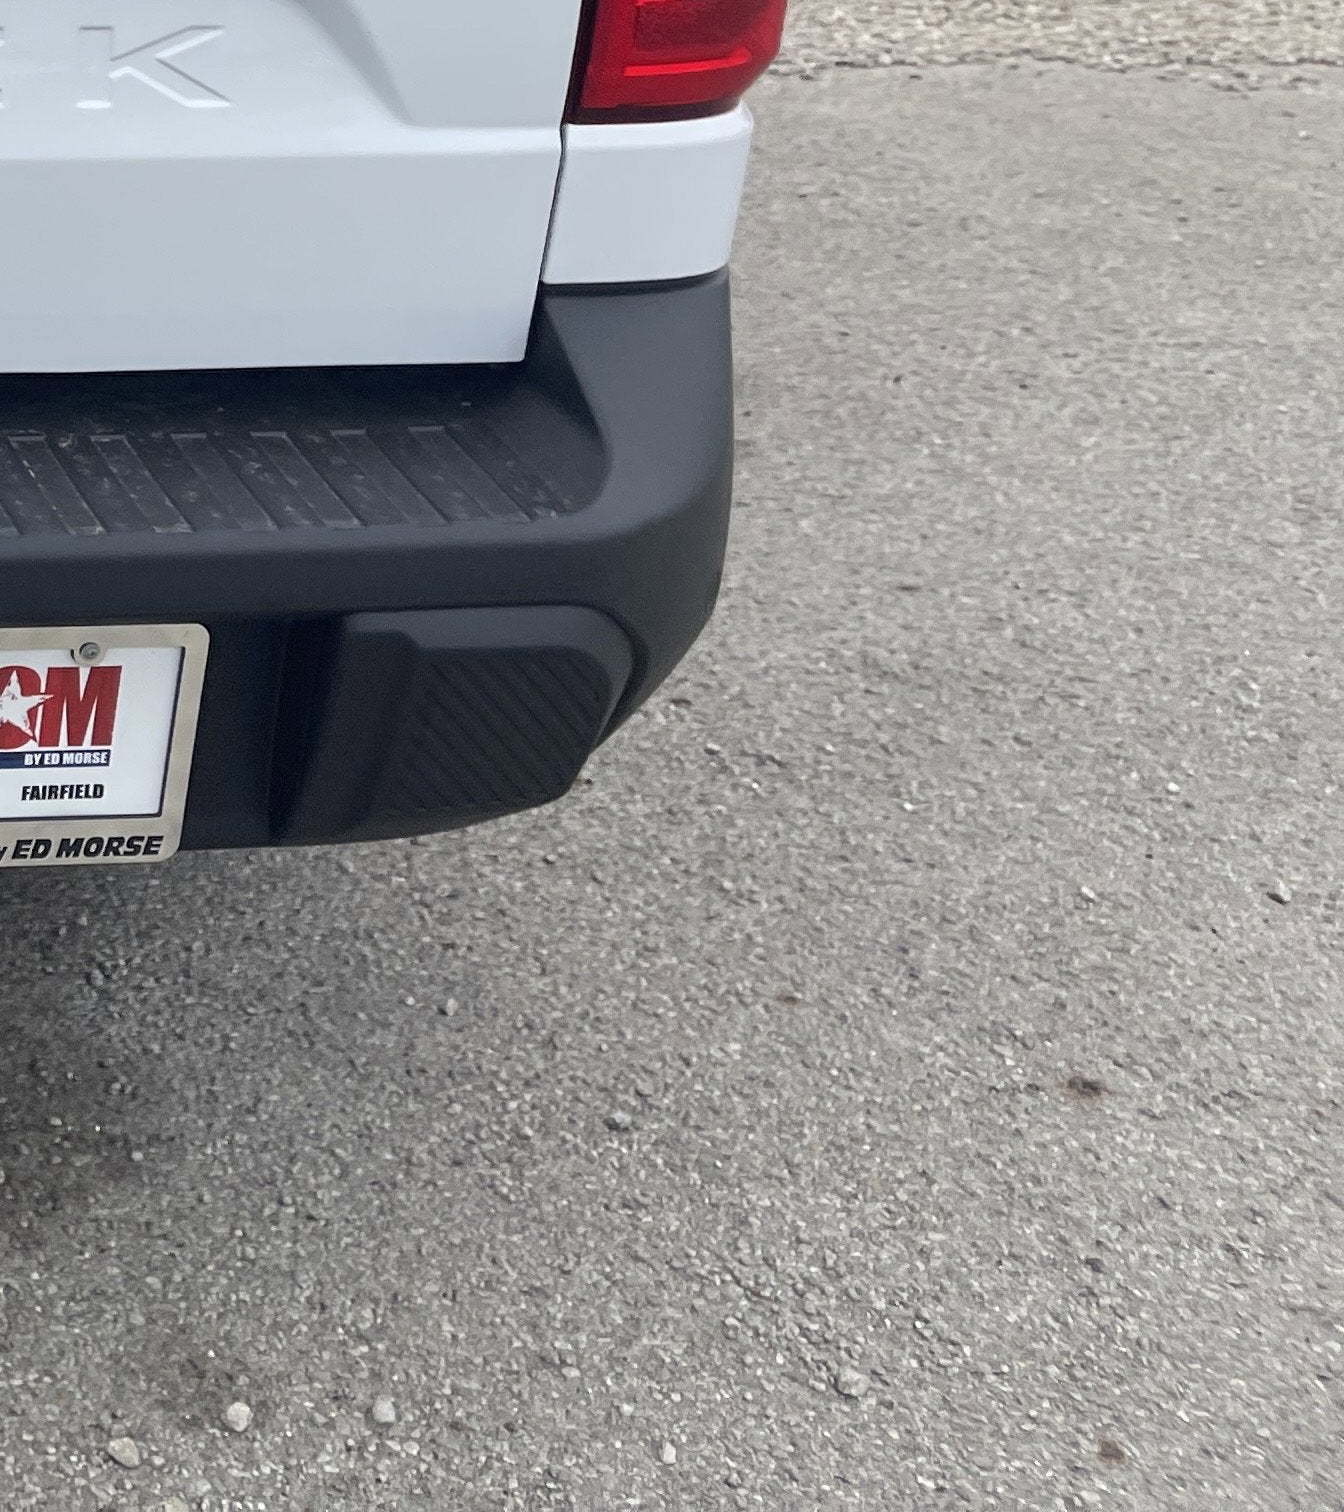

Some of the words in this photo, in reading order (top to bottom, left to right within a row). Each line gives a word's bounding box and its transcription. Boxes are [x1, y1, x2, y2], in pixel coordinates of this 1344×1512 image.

[24, 753, 42, 766] BY
[43, 753, 61, 765] ED
[62, 751, 108, 765] MORSE
[21, 784, 104, 801] FAIRFIELD
[12, 839, 53, 860] ED
[56, 835, 165, 859] MORSE
